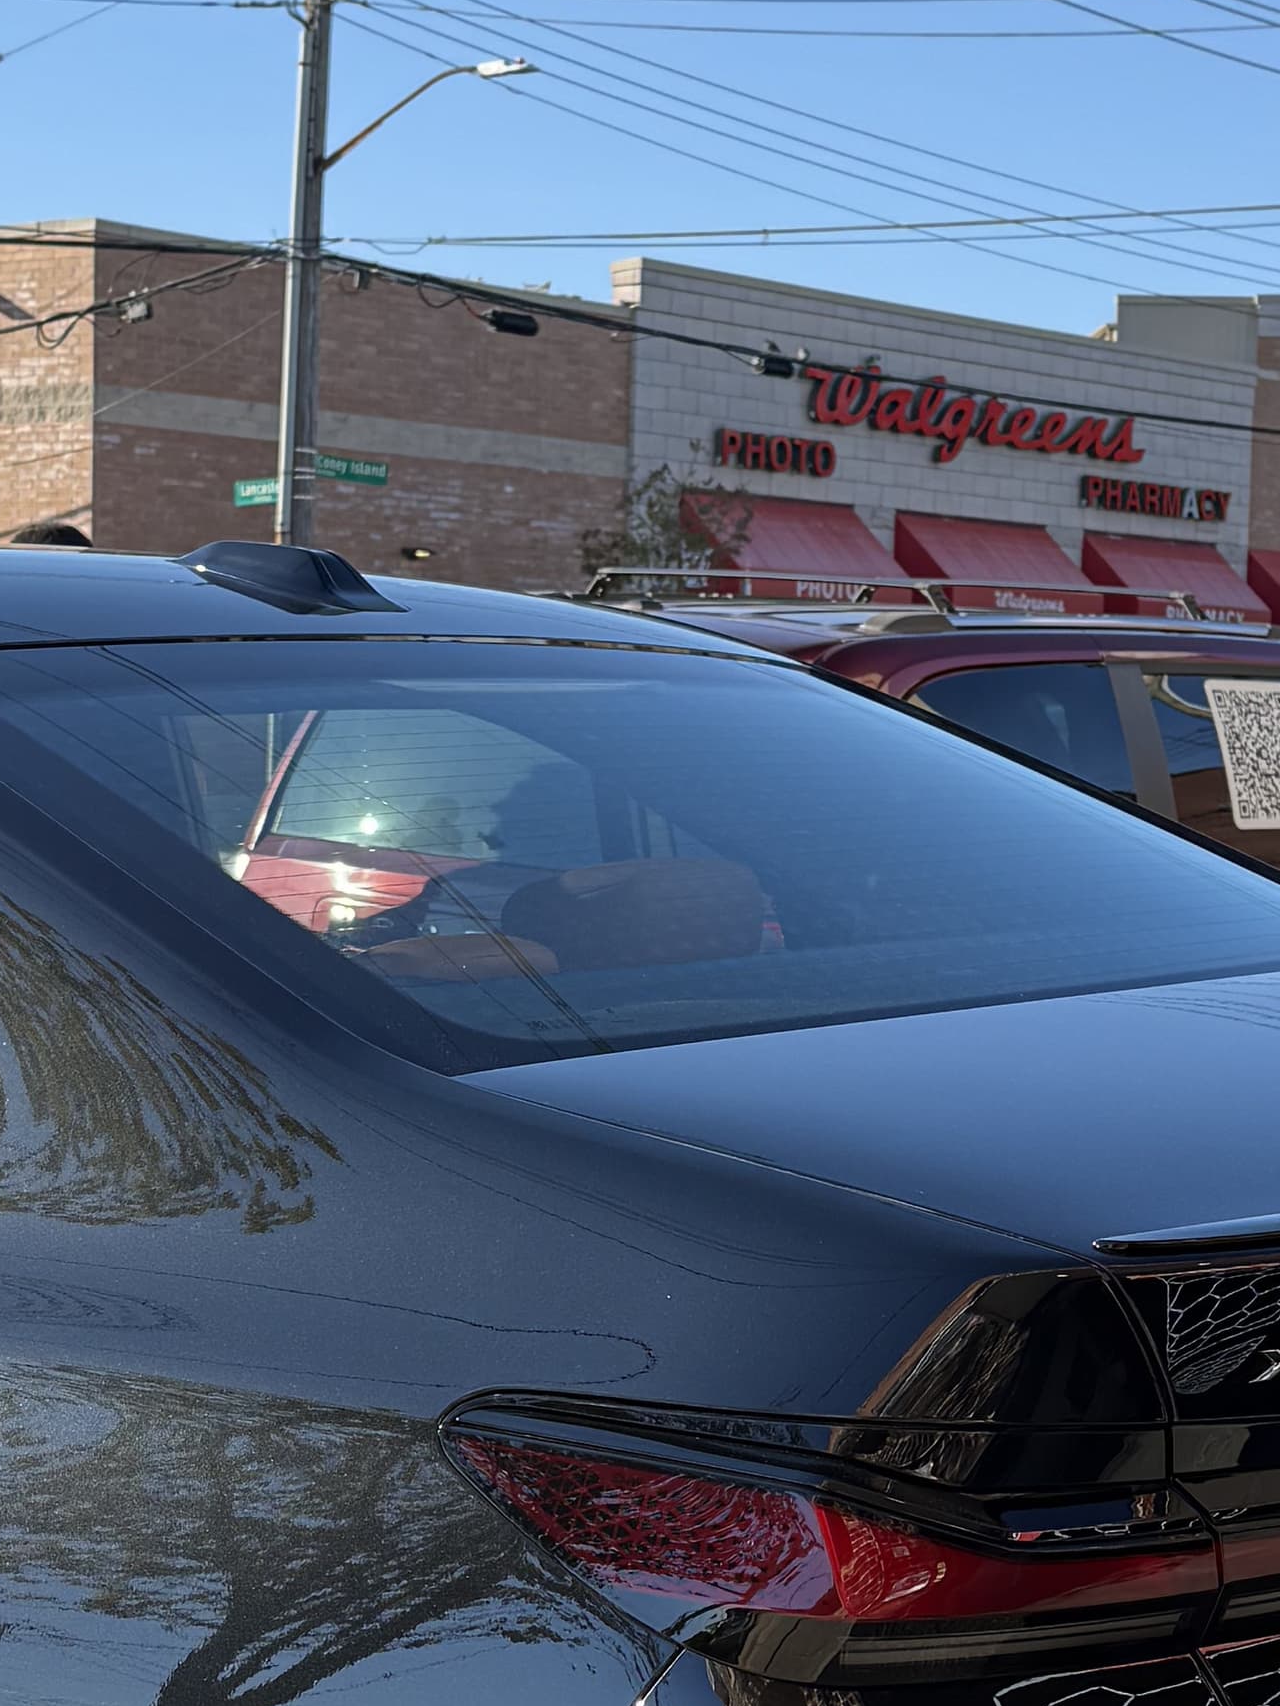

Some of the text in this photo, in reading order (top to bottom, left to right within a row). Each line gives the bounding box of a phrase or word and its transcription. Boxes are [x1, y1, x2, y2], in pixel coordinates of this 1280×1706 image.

[806, 366, 1145, 464] Walgreens
[351, 460, 387, 478] Island
[720, 427, 837, 478] PHOTO
[1082, 475, 1232, 522] PHARMACY
